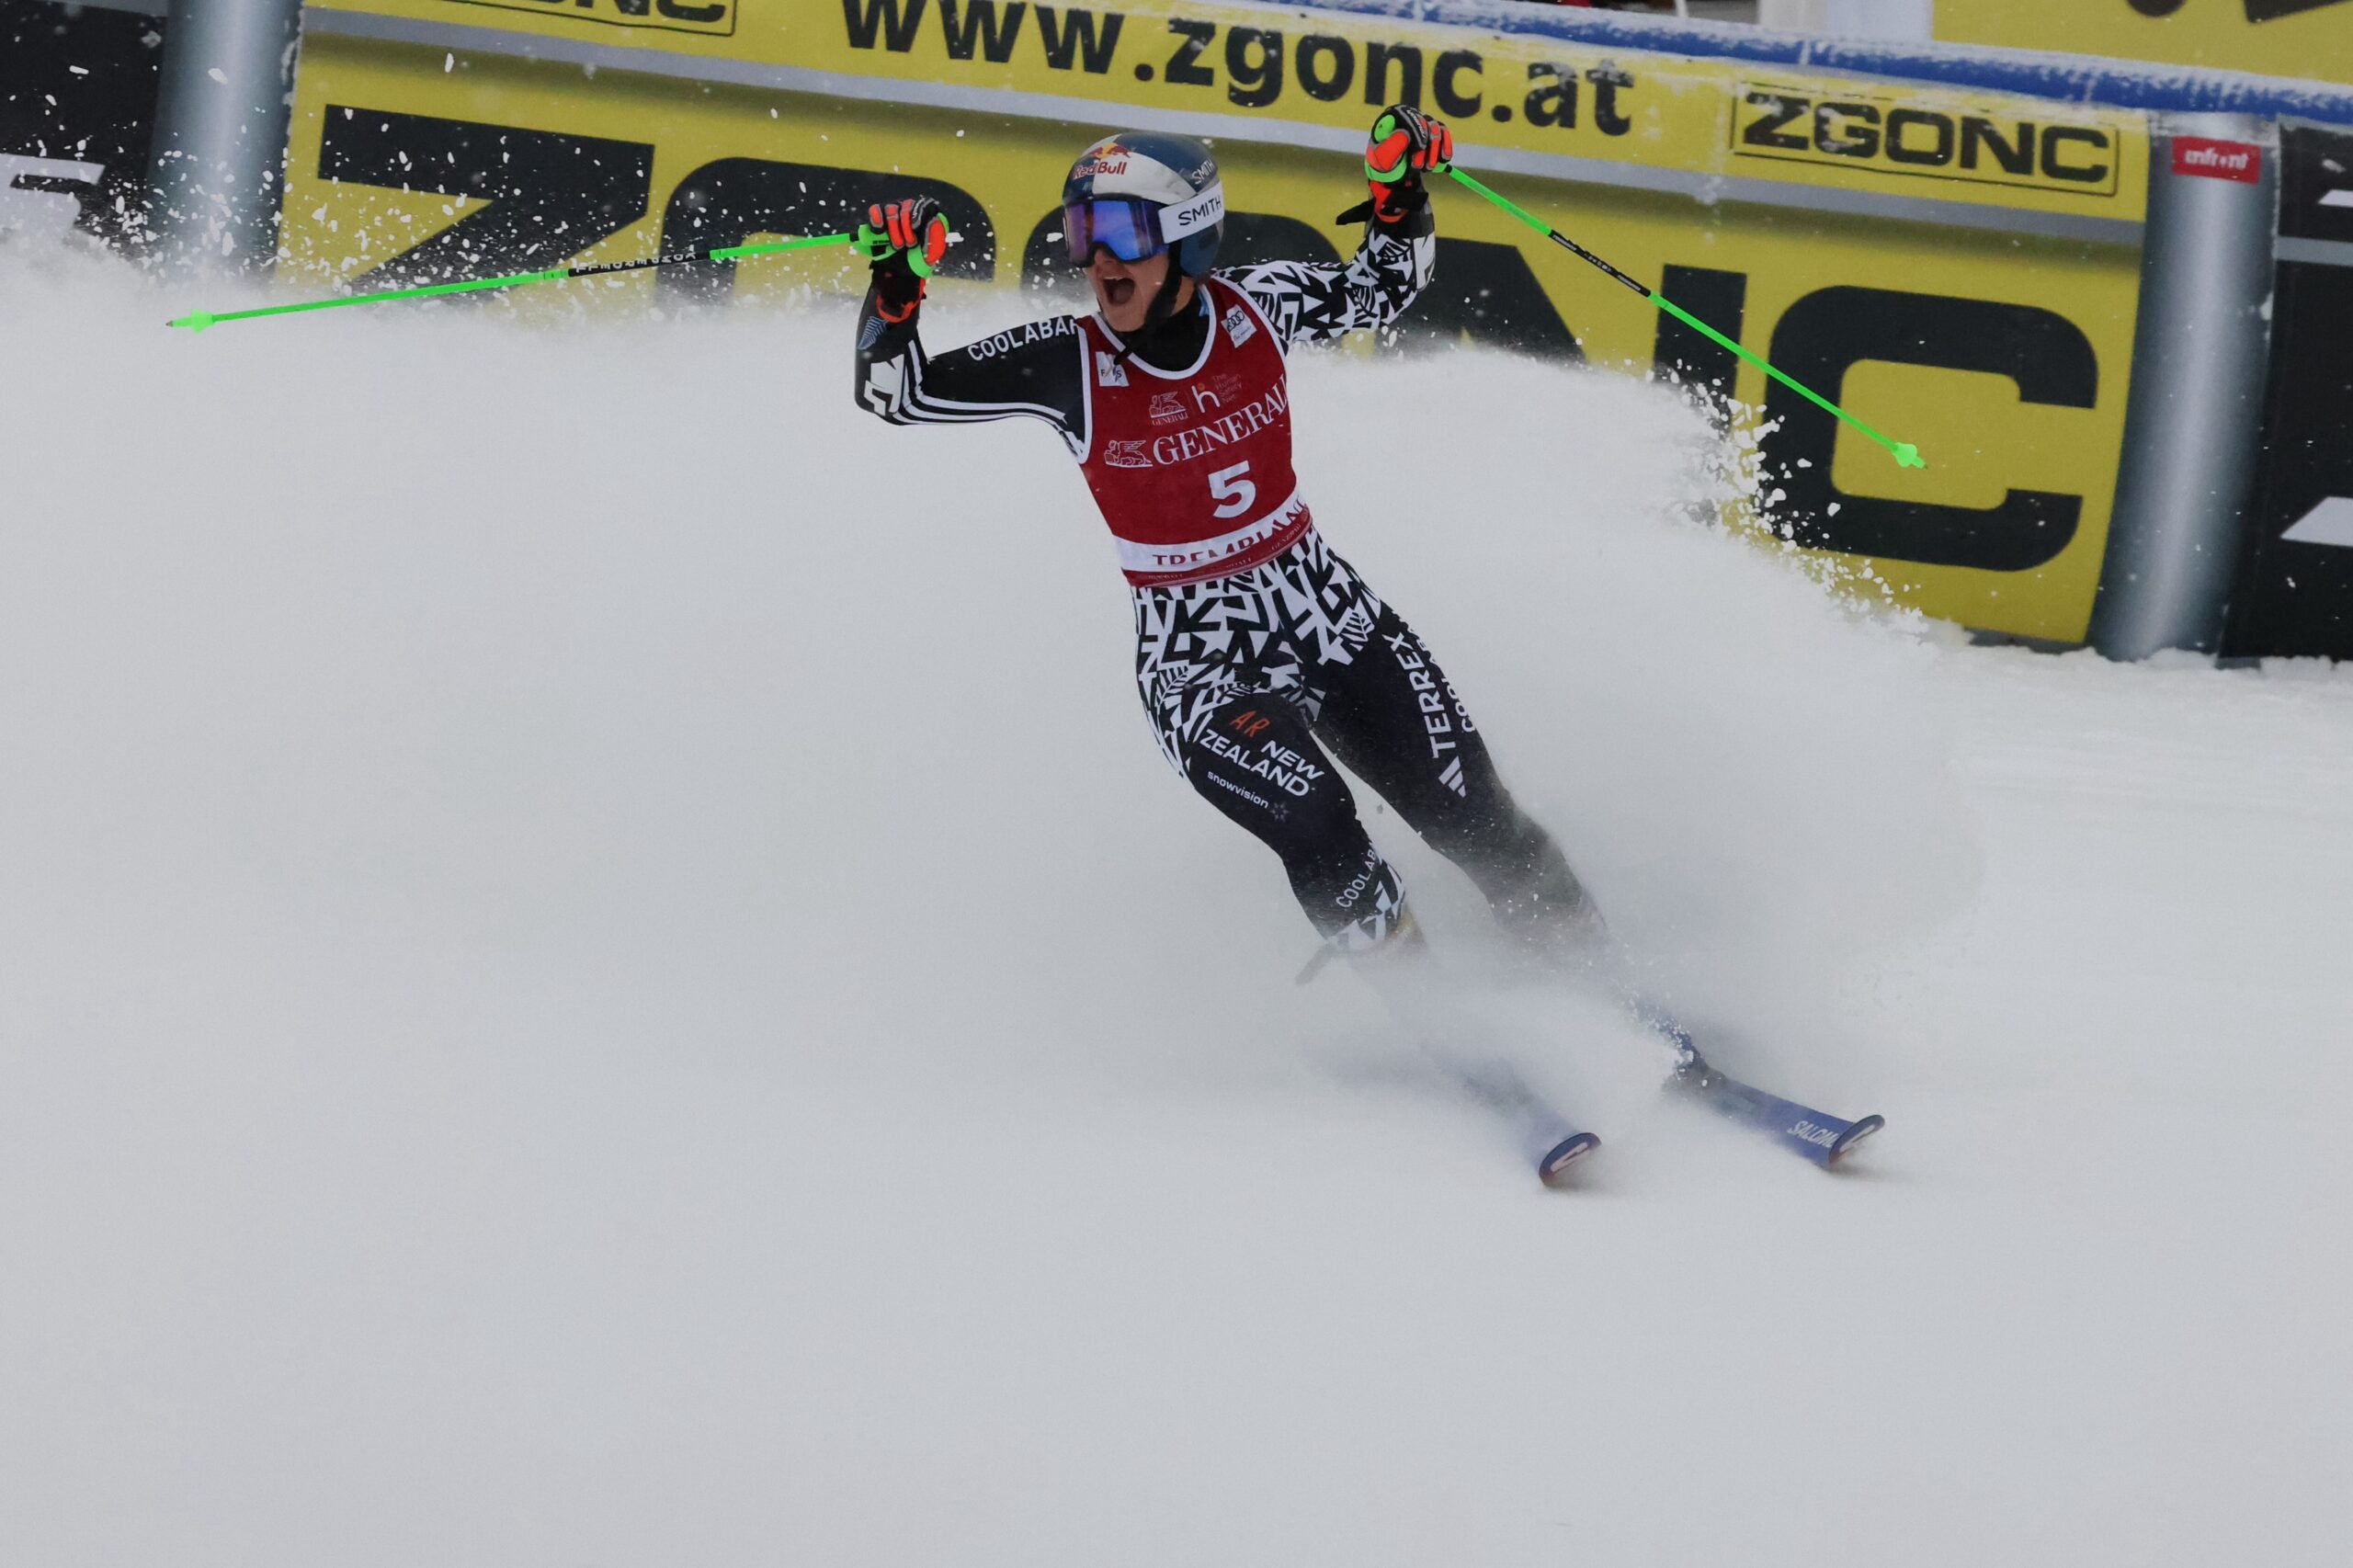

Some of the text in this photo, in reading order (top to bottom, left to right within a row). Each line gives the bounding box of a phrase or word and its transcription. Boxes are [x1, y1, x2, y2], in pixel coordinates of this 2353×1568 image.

[842, 0, 1634, 137] www.zgonc.at
[1743, 92, 2109, 183] ZGONC
[1097, 161, 1127, 176] Bull
[1191, 159, 1215, 185] SMITH
[1177, 195, 1222, 226] SMITH
[1208, 460, 1256, 518] 5
[1381, 632, 1457, 759] TERREX
[1229, 710, 1271, 738] AR
[1199, 728, 1310, 797] ZEALAND
[1260, 740, 1325, 780] NEW
[1207, 770, 1269, 809] snowvision
